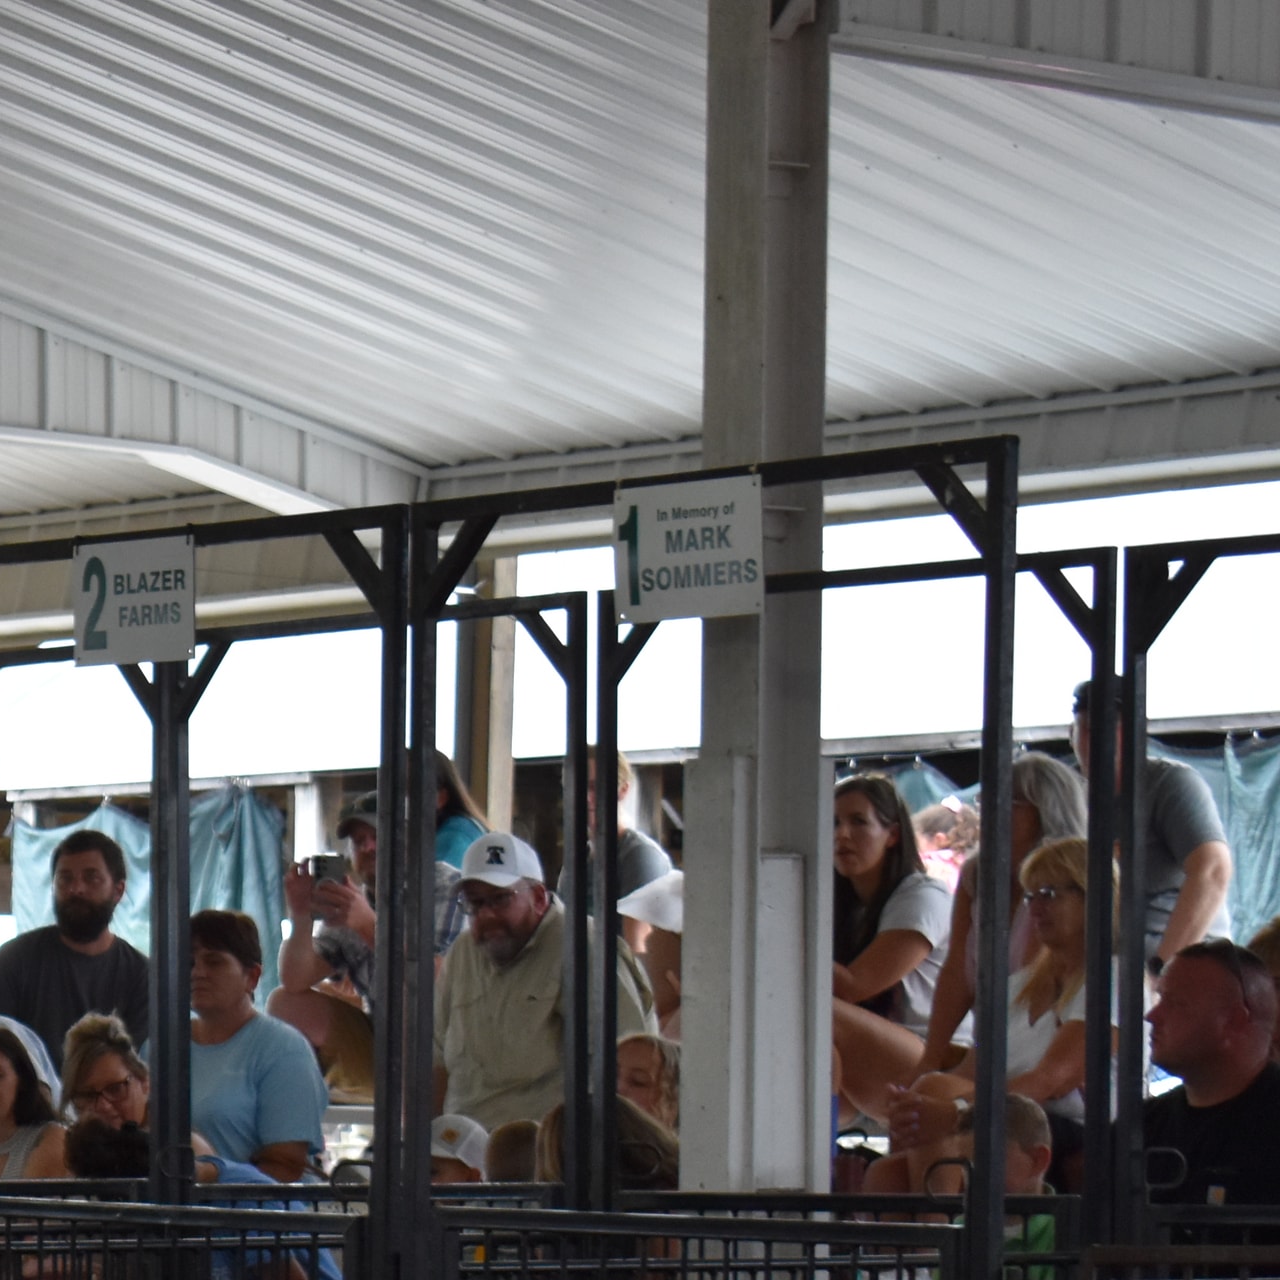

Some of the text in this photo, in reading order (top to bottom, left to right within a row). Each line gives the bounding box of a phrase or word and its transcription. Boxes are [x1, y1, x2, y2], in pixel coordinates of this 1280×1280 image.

[657, 502, 735, 522] In Memory of
[665, 525, 732, 554] MARK
[618, 505, 641, 606] 1
[113, 569, 186, 595] BLAZER
[642, 559, 758, 592] SOMMERS
[82, 556, 107, 651] 2
[119, 602, 181, 627] FARMS
